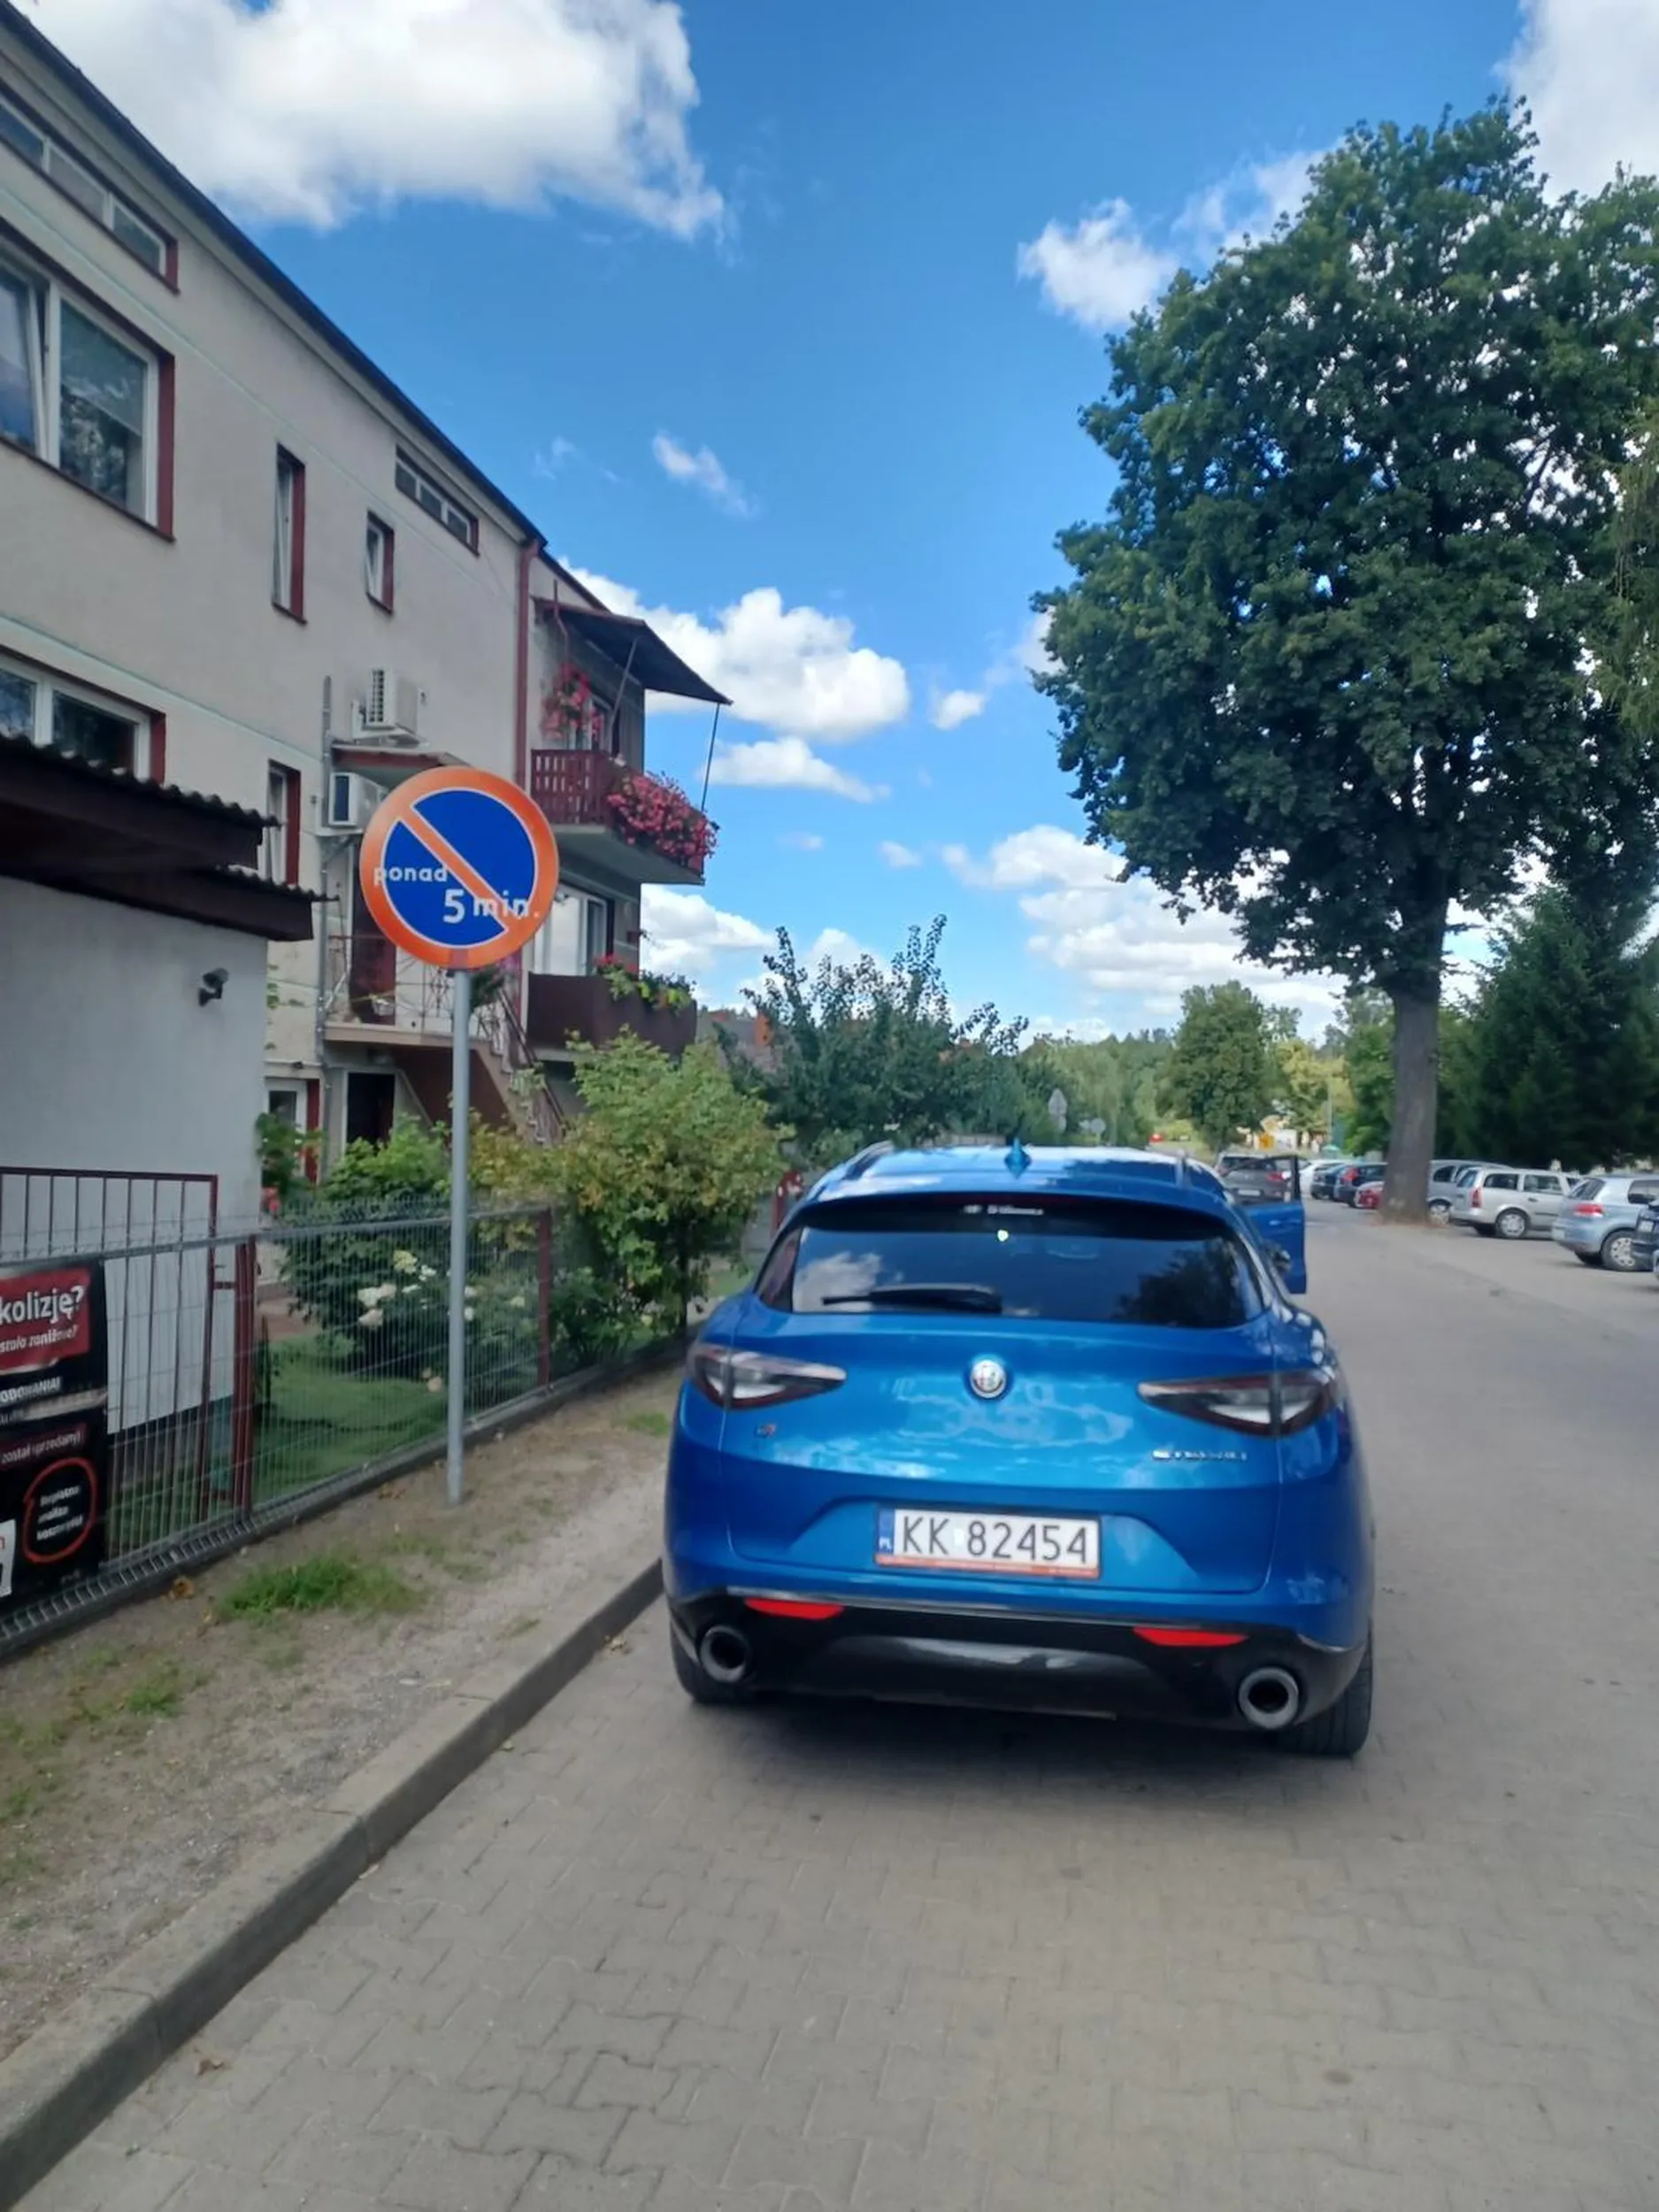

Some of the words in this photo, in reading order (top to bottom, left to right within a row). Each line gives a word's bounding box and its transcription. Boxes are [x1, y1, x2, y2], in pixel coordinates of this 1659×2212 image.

[373, 863, 449, 887] ponad
[443, 888, 465, 924] 5
[472, 890, 540, 921] min.
[0, 1285, 86, 1324] kolizję?
[902, 1516, 950, 1555] KK
[966, 1520, 1087, 1564] 82454
